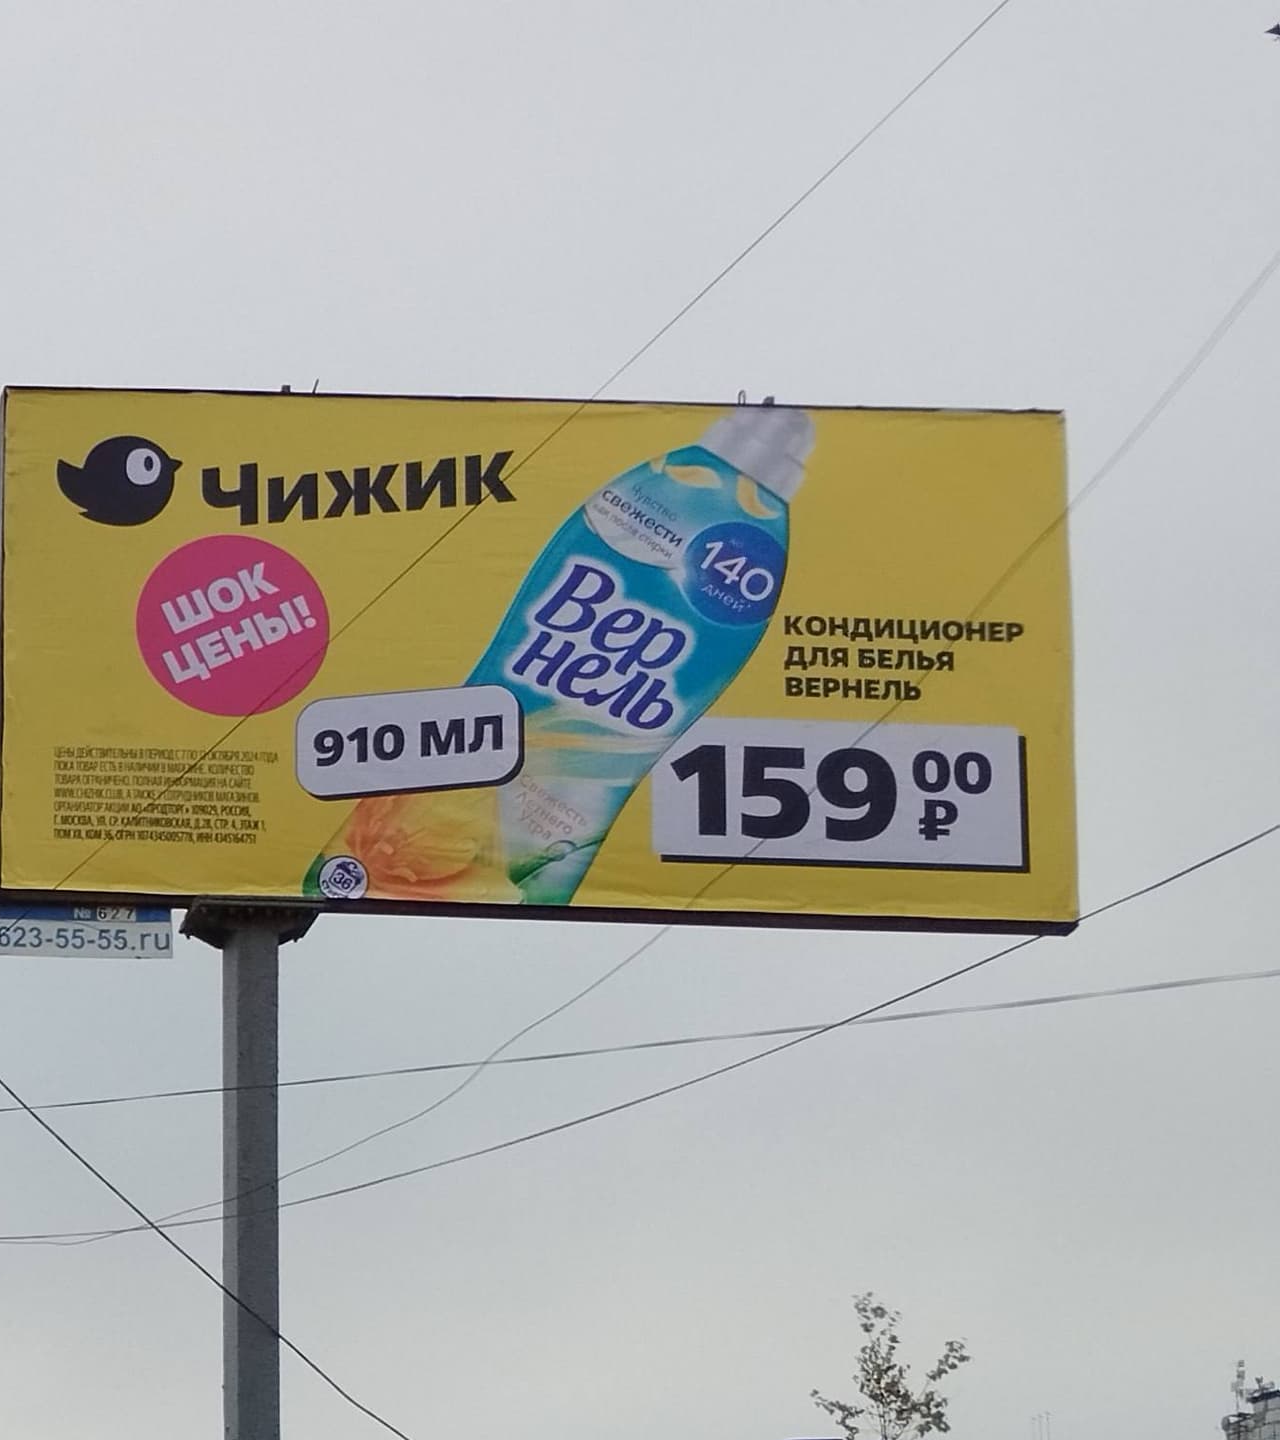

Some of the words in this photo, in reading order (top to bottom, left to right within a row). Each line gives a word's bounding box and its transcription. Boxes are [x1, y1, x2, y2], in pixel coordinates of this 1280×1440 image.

[201, 450, 517, 526] Чижик
[601, 489, 684, 549] свежести
[160, 562, 280, 635] ШОК
[700, 541, 775, 602] 140
[162, 595, 317, 684] ЦЕНЫ!
[534, 564, 686, 676] Вер
[783, 615, 1025, 643] КОНДИЦИОНЕР
[511, 630, 674, 730] нель
[783, 645, 849, 671] ДЛЯ
[857, 649, 955, 672] БЕЛЬЯ
[784, 676, 922, 701] ВЕРНЕЛЬ
[313, 724, 406, 767] 910
[420, 715, 504, 757] МЛ
[670, 744, 898, 842] 159
[911, 750, 993, 795] 00
[333, 872, 353, 890] 36
[96, 908, 134, 919] 627
